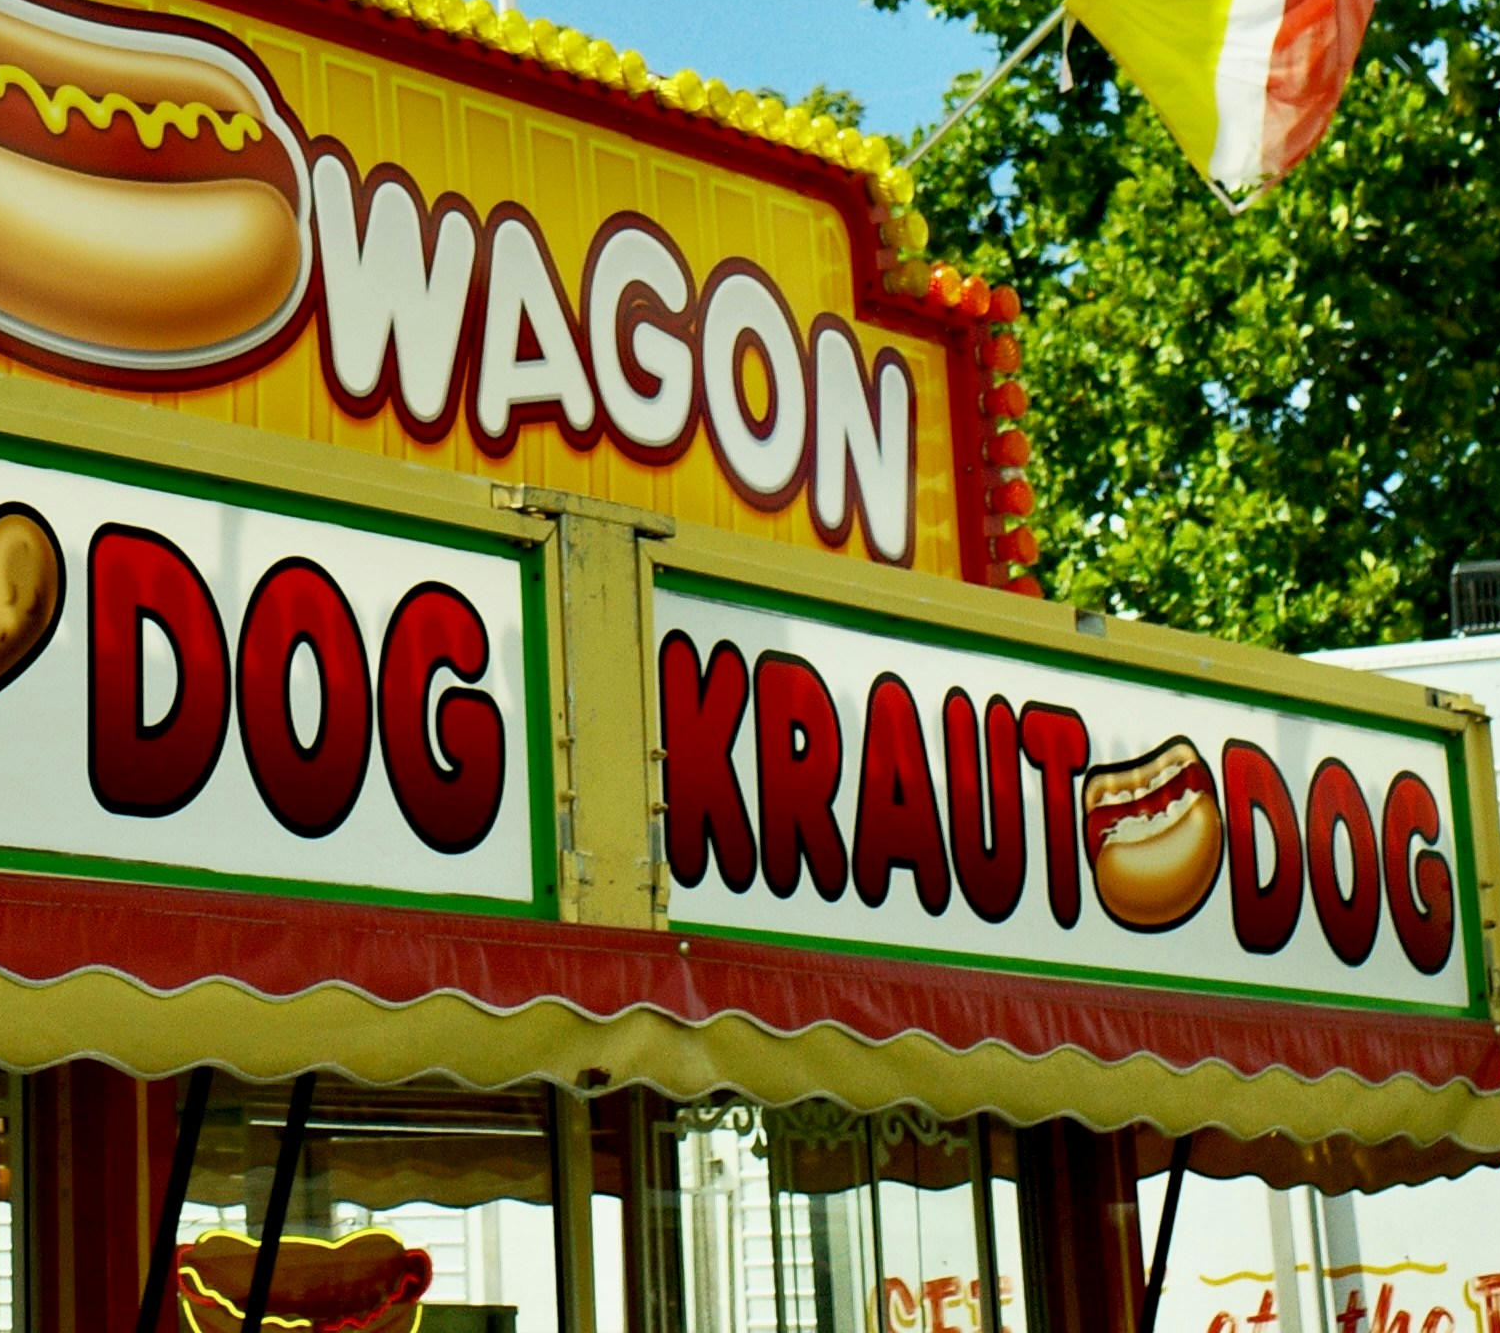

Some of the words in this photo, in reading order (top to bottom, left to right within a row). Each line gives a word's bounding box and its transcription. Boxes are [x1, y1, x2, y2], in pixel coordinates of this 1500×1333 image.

[303, 133, 919, 570] WAGON
[86, 520, 506, 856] DOG
[658, 627, 1091, 931] KRAUT
[1221, 737, 1456, 975] DOG
